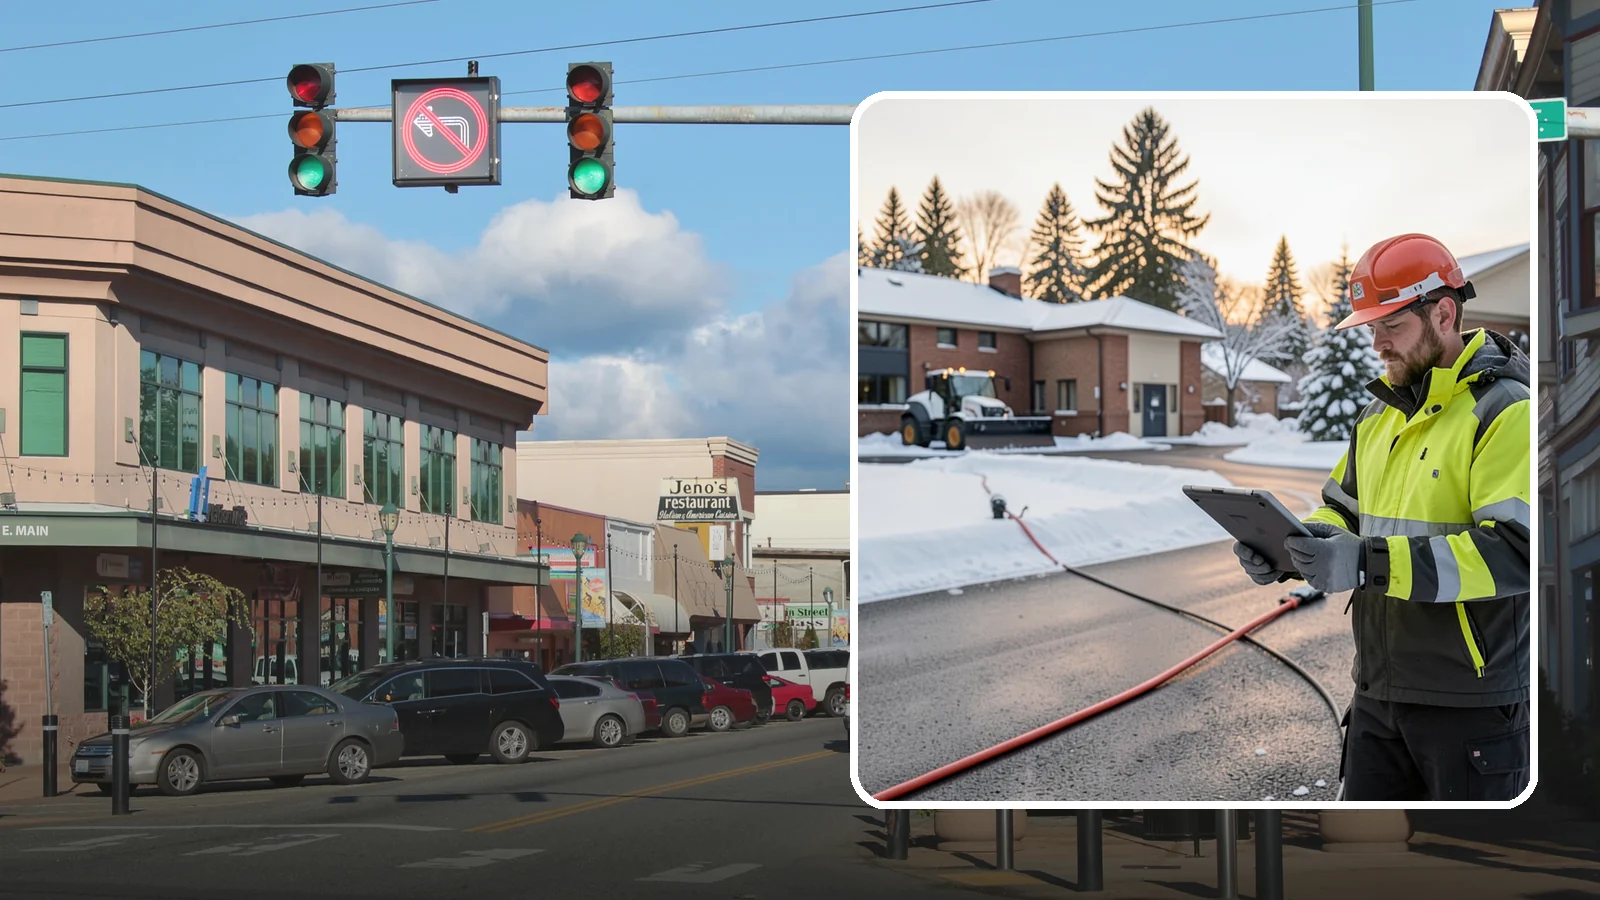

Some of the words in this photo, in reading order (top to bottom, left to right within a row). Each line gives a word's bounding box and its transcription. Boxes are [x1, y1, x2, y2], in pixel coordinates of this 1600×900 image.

[670, 480, 727, 494] Jeno's
[665, 497, 731, 509] restaurant
[686, 510, 714, 519] American
[715, 510, 737, 519] Cuisine
[2, 525, 13, 536] E.
[15, 525, 49, 537] MAIN
[797, 608, 828, 617] Street
